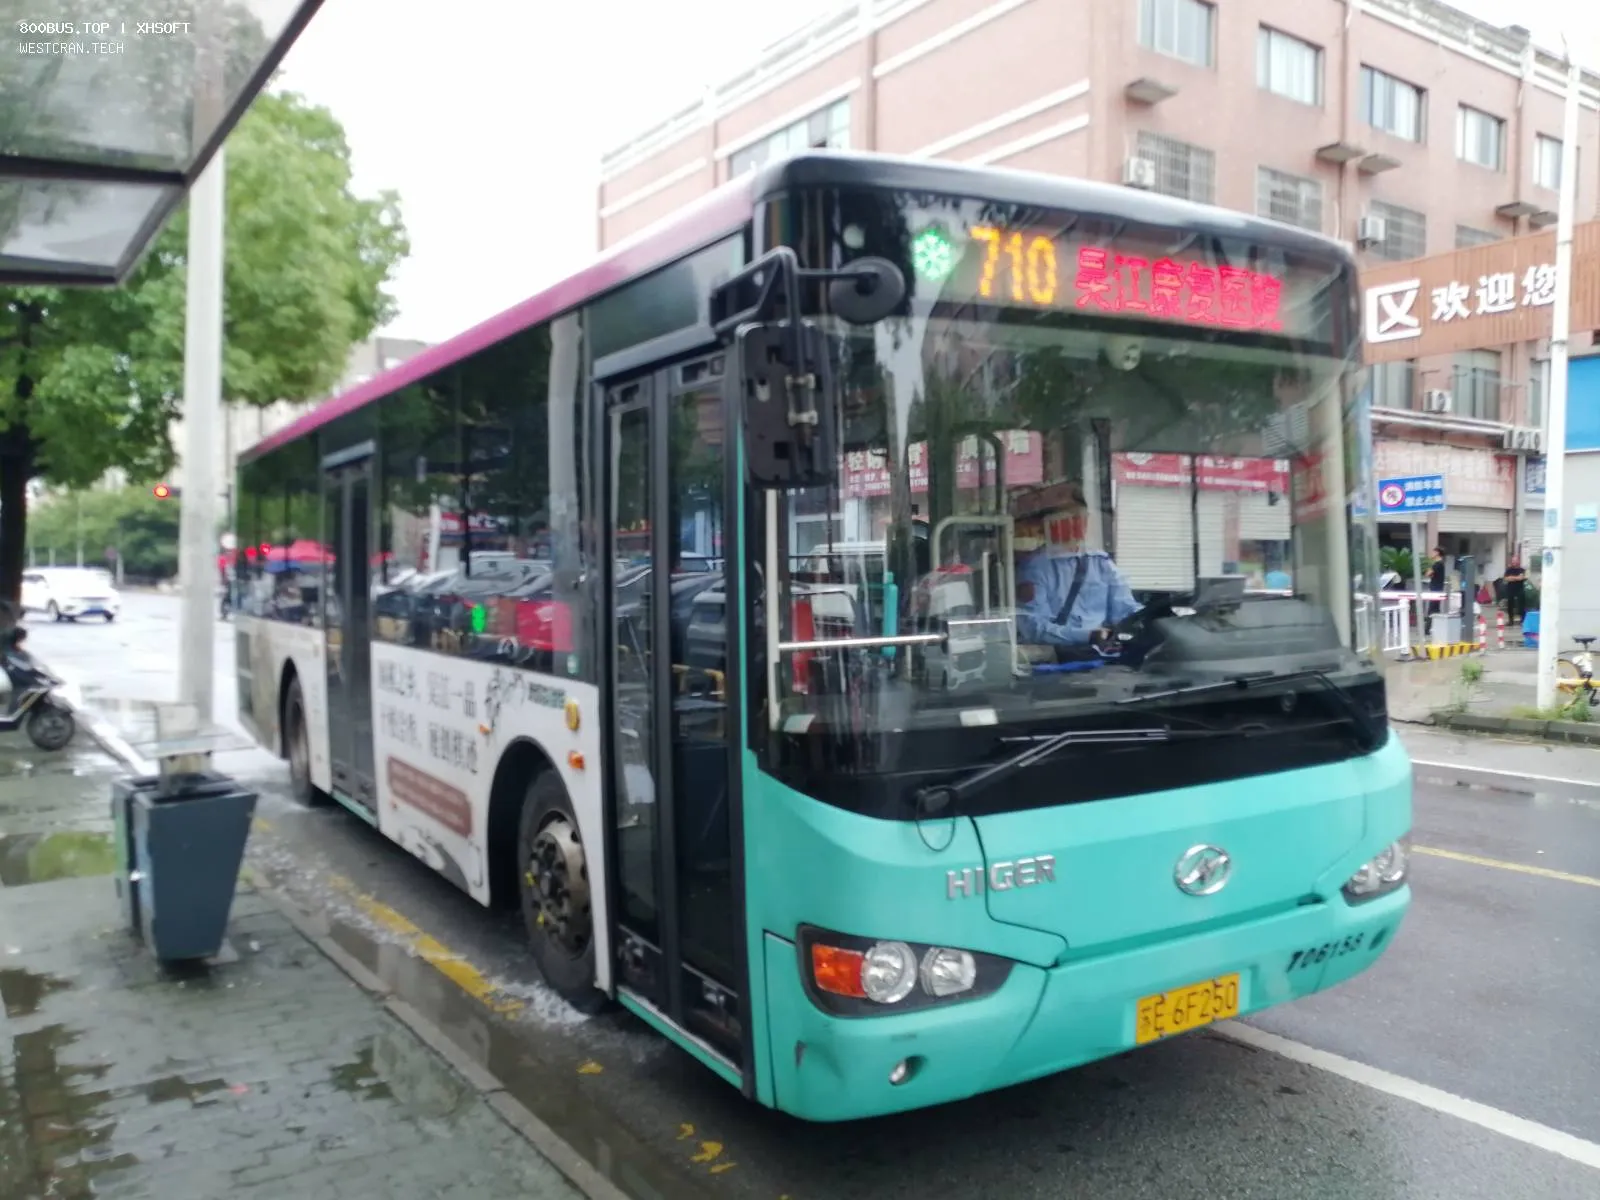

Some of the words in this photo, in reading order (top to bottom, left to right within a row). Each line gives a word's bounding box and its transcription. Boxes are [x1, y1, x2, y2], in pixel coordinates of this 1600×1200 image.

[969, 225, 1057, 305] 710
[1365, 278, 1422, 343] 区
[1431, 262, 1558, 322] 欢迎您
[946, 854, 1057, 900] HIGER
